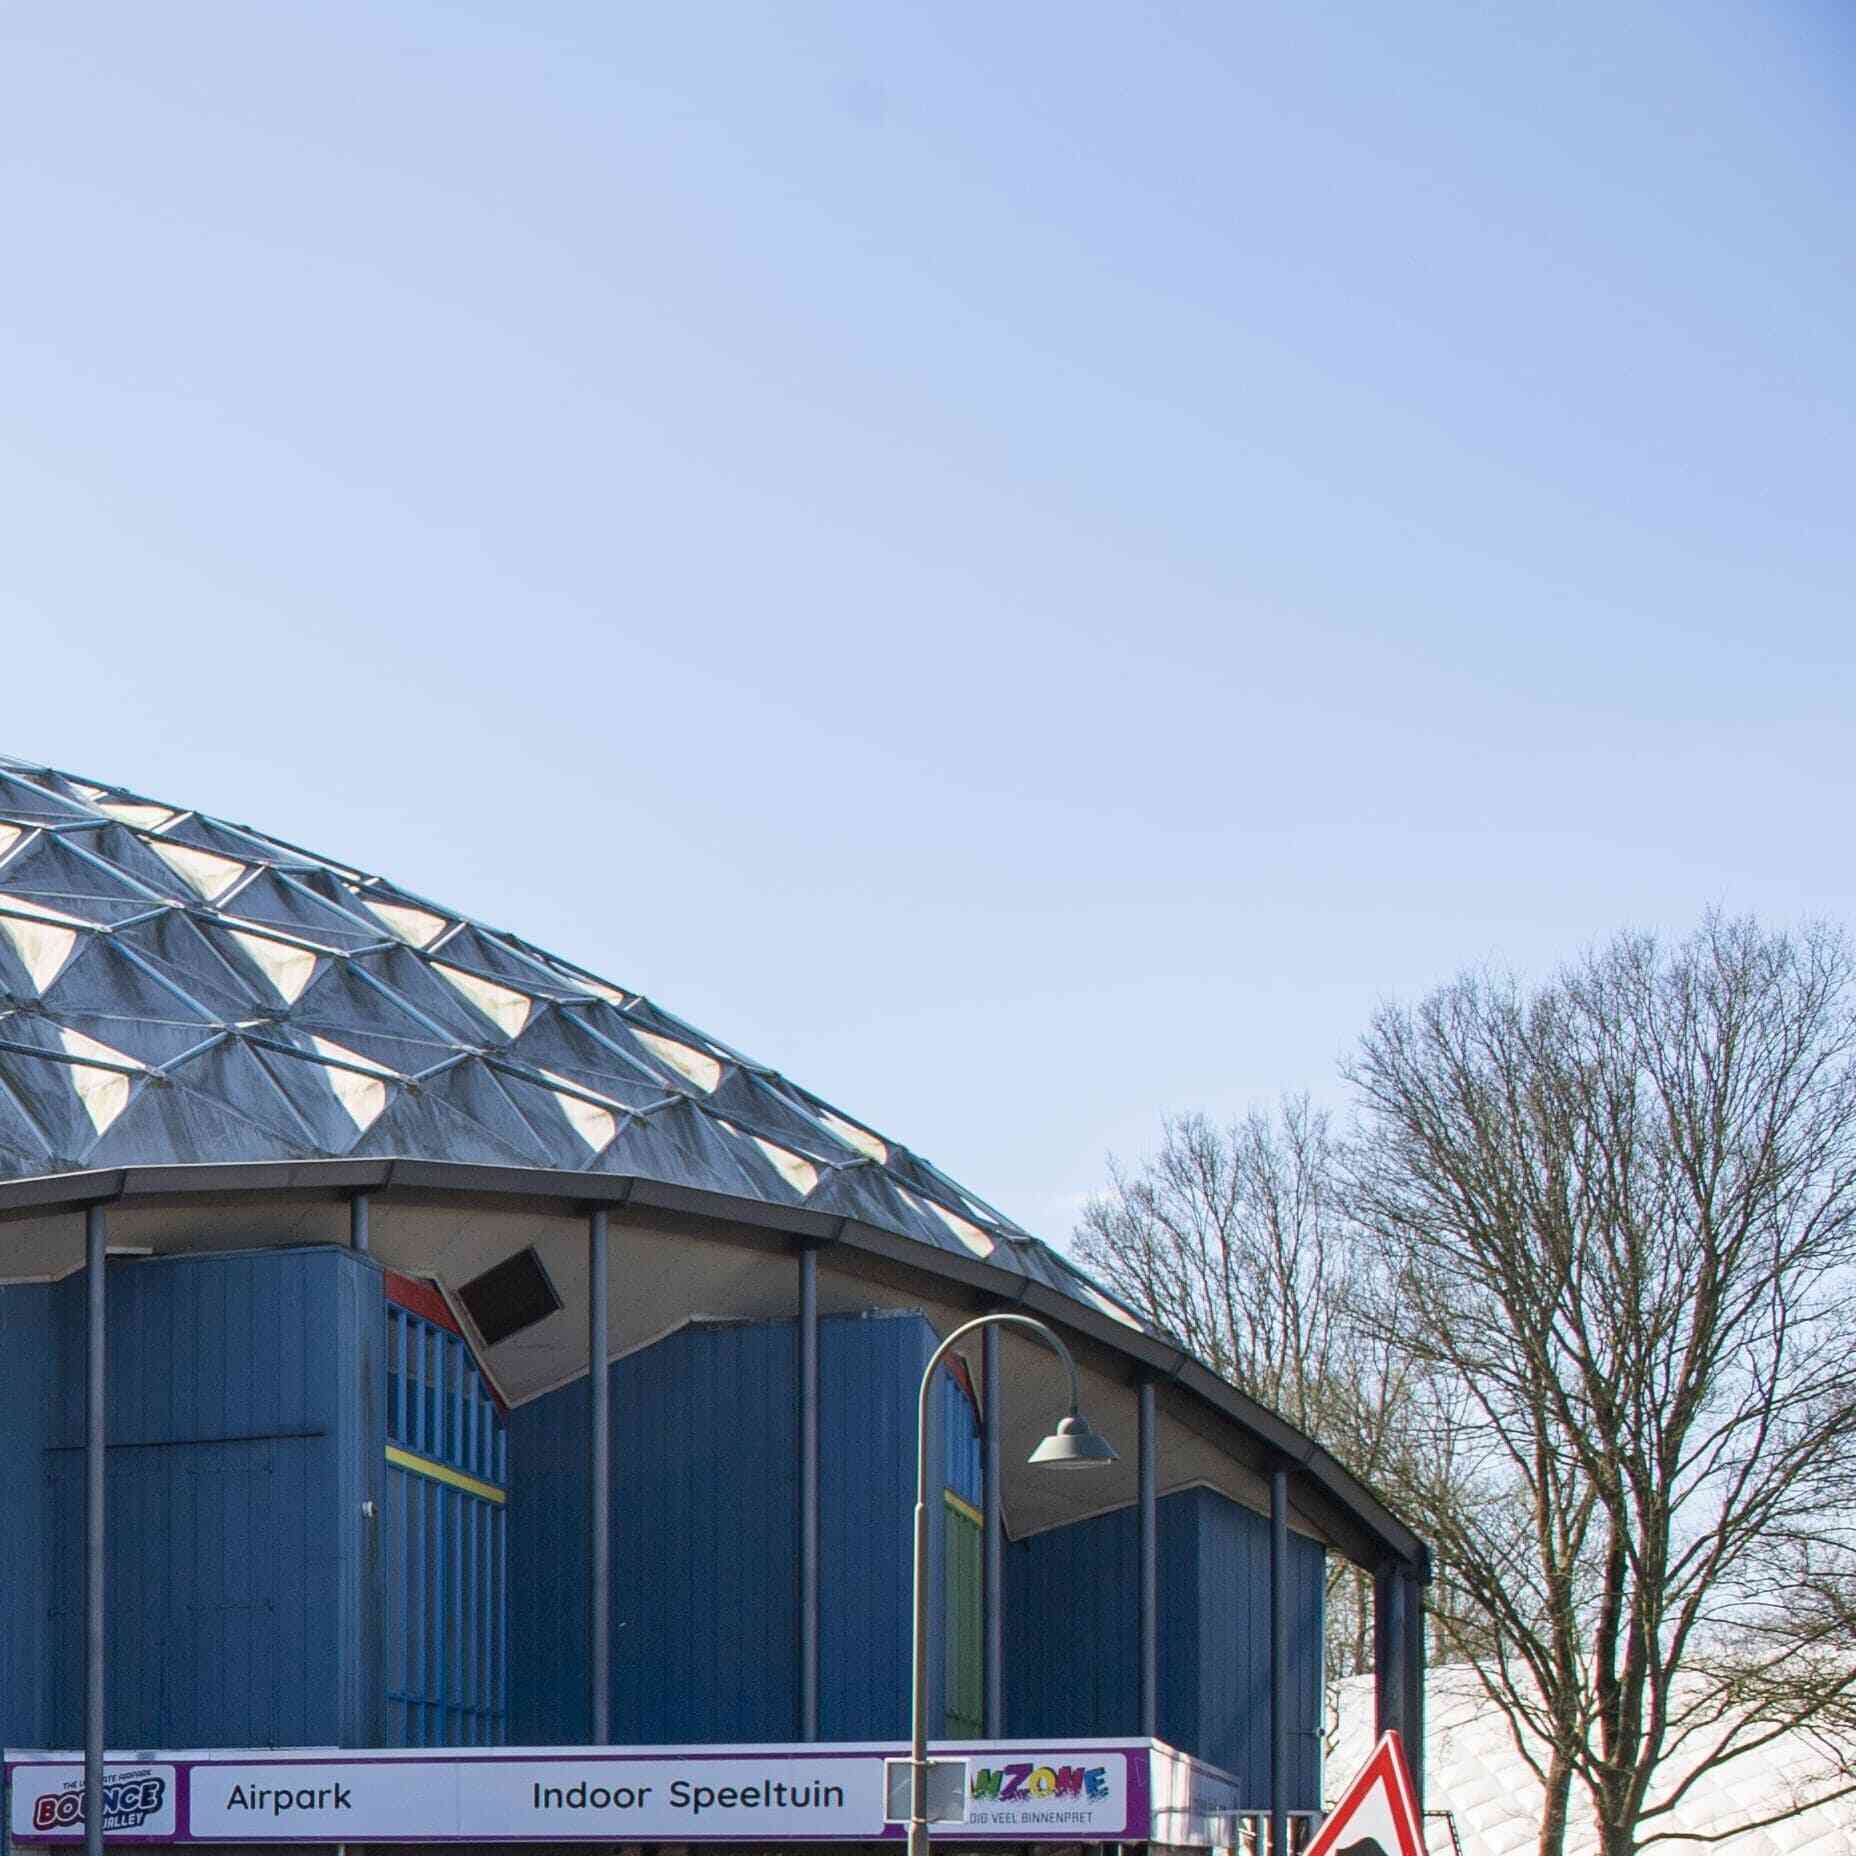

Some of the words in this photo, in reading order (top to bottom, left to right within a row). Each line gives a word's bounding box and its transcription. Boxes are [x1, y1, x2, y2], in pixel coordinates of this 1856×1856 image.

[63, 1781, 78, 1791] THE
[226, 1782, 352, 1816] Airpark
[534, 1781, 652, 1809] Indoor
[669, 1780, 844, 1815] Speeltuin
[971, 1763, 1109, 1801] NZONE
[992, 1812, 1017, 1824] VEEL
[1021, 1811, 1093, 1824] BINNENPRET
